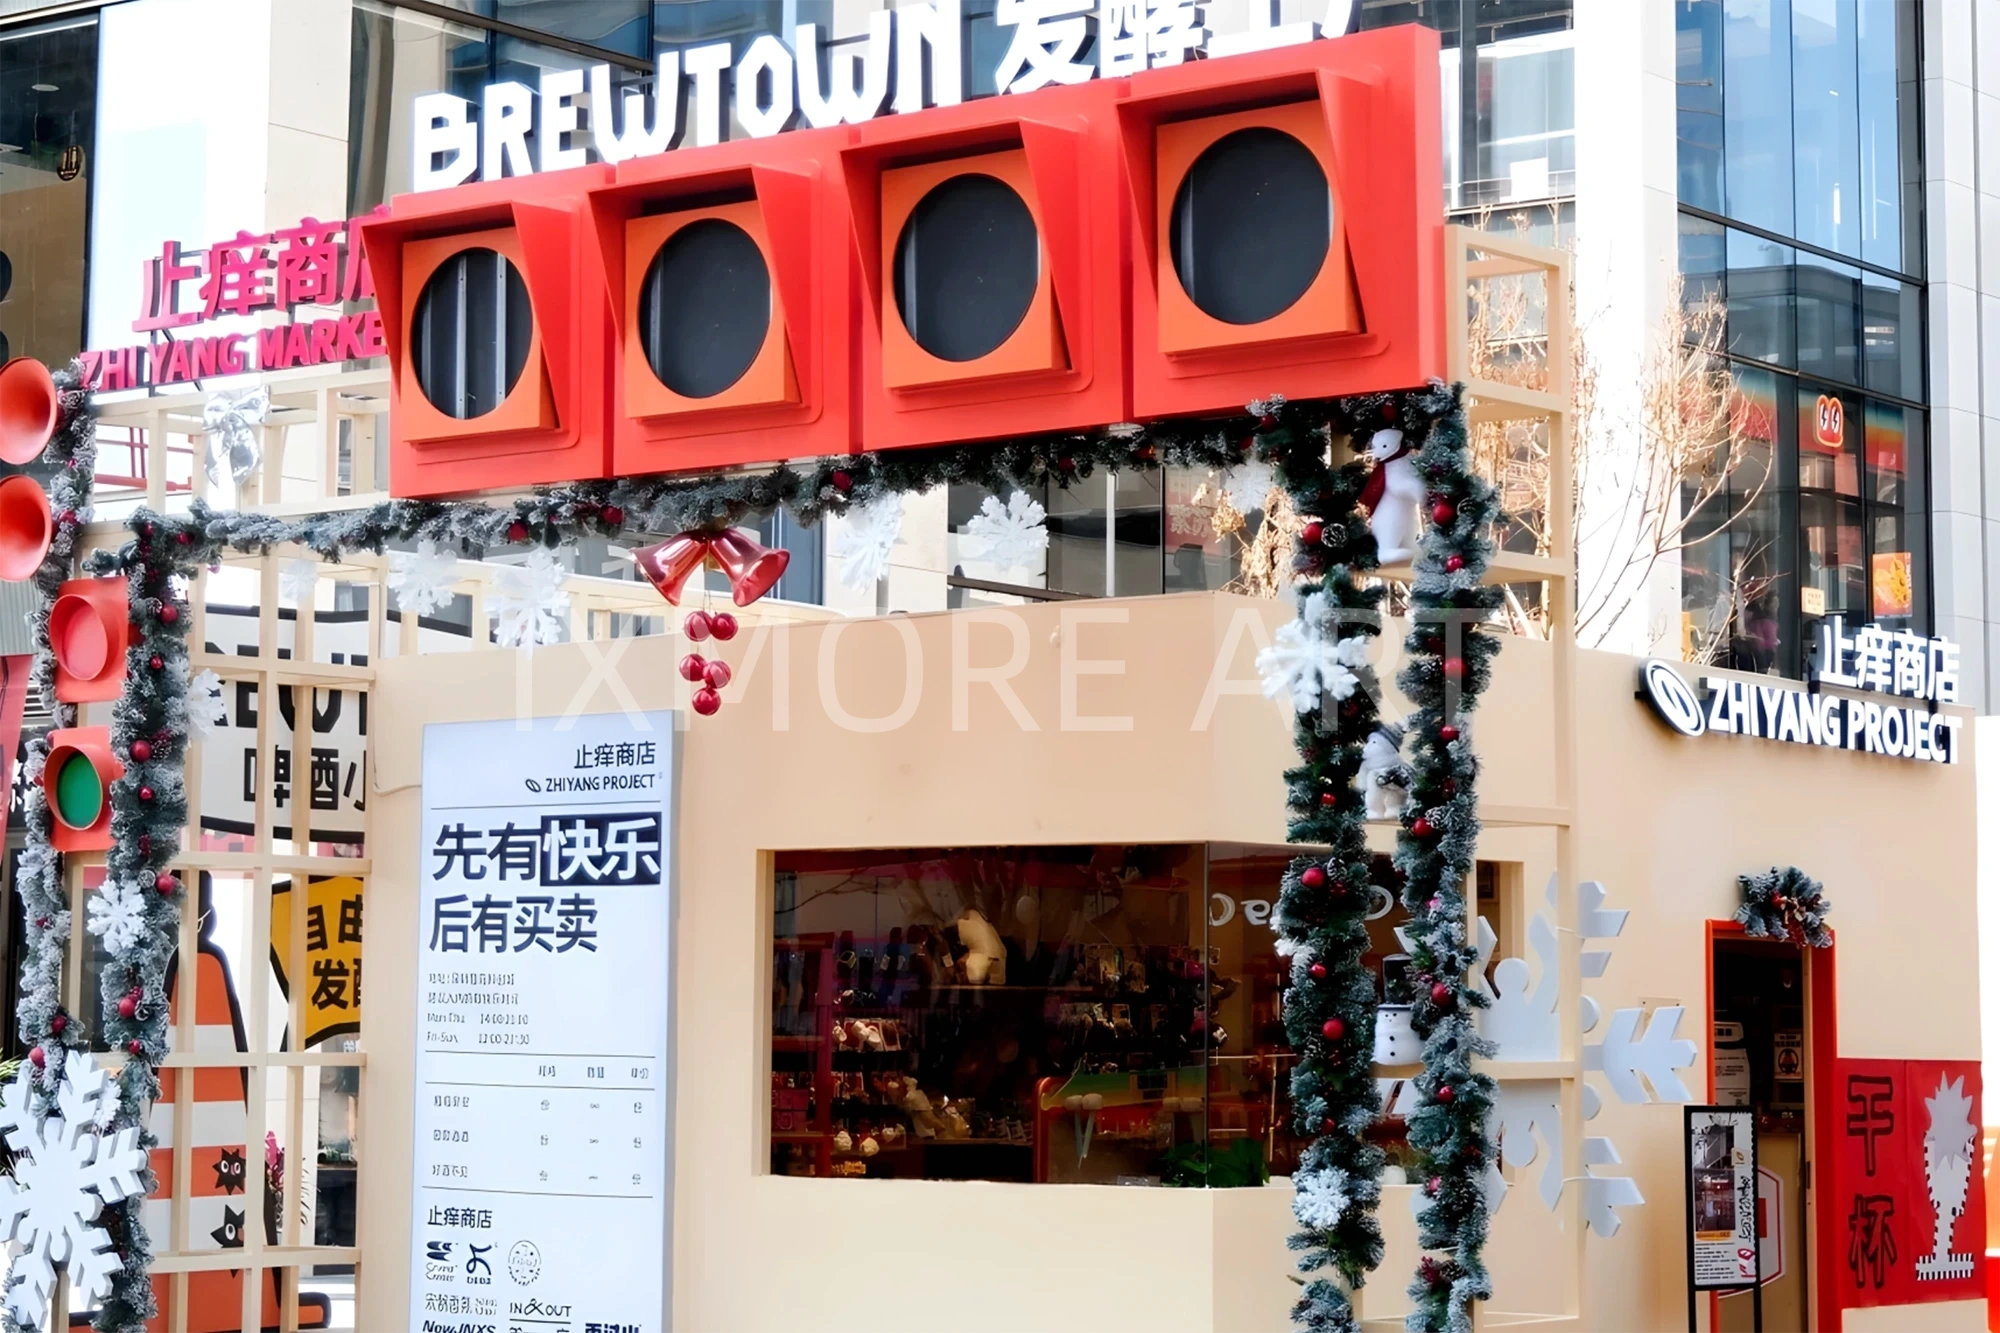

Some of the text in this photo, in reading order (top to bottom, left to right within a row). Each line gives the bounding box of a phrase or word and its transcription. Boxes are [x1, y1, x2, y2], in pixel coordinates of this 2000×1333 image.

[413, 0, 962, 194] BREWTOWN
[1820, 615, 1961, 703] 止痒商店
[1705, 677, 1963, 765] ZHIYANG PROJECT
[545, 773, 656, 793] ZHIYANG PROJECT
[573, 741, 656, 769] 止痒商店
[431, 816, 662, 882] 先有快乐
[429, 892, 598, 954] 后有买卖
[427, 1205, 493, 1229] 止痒商店
